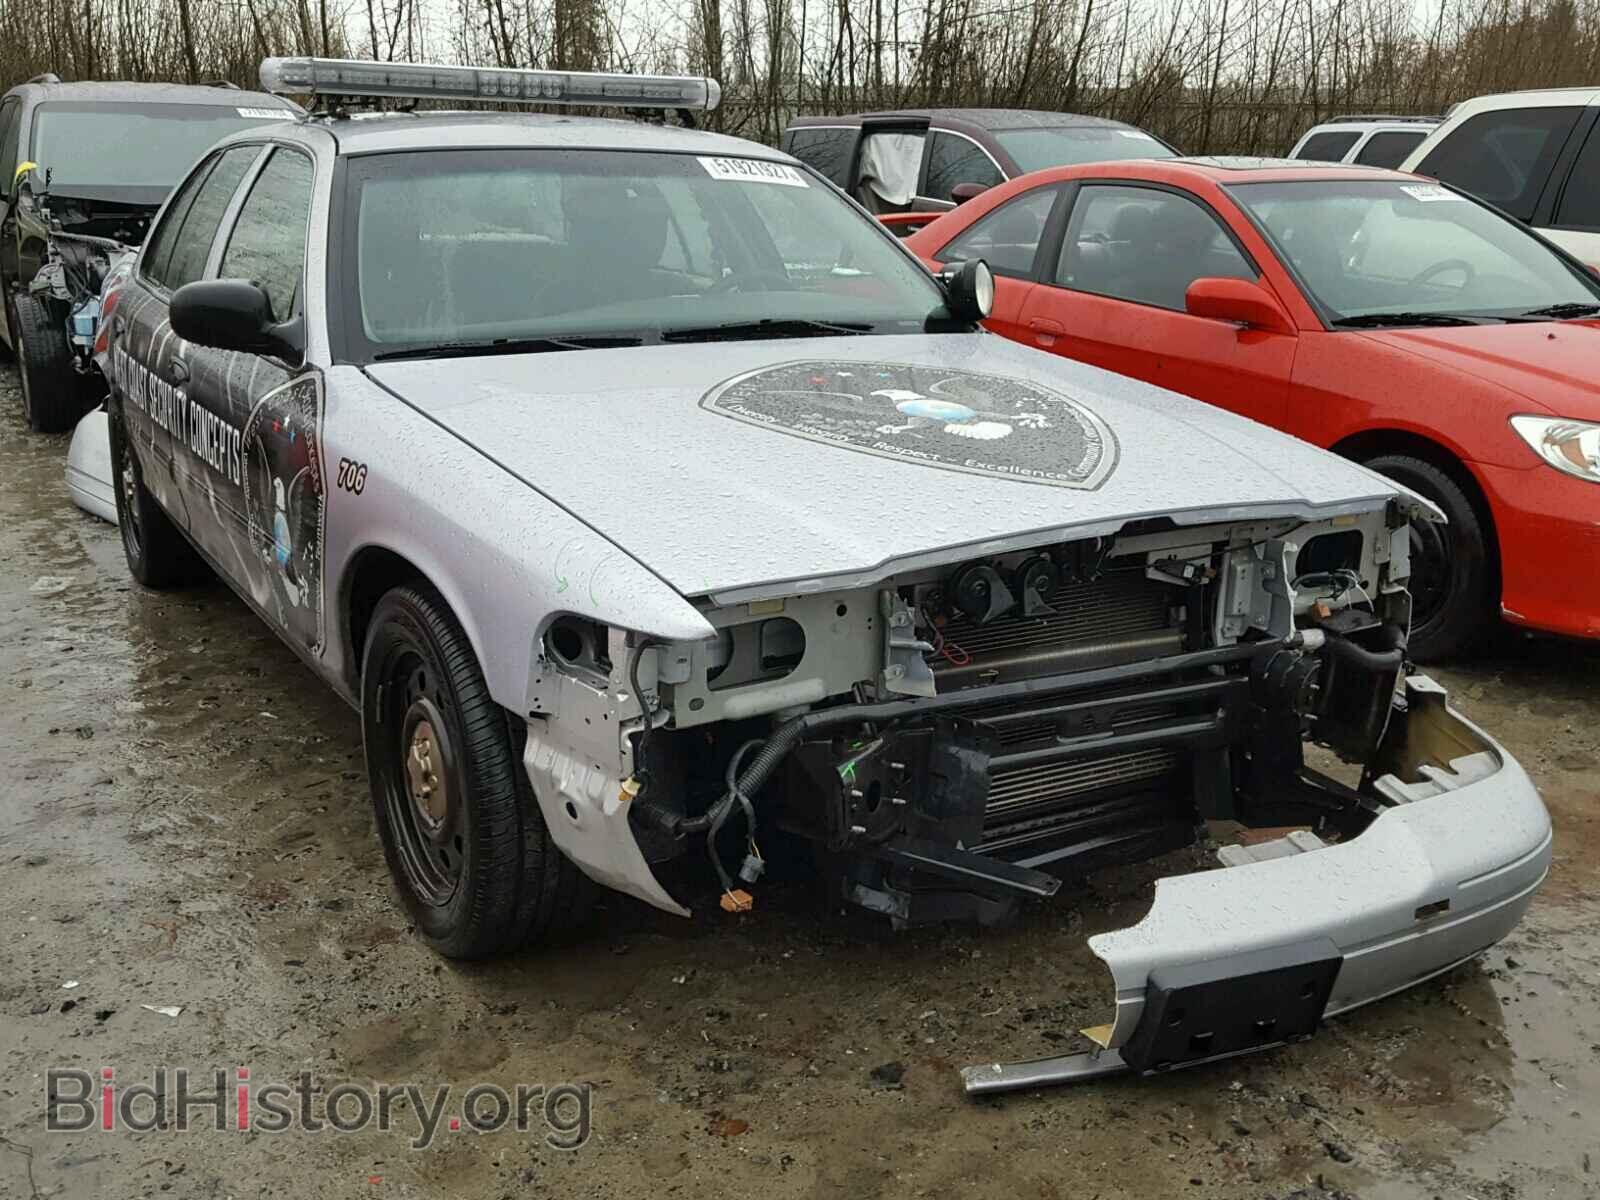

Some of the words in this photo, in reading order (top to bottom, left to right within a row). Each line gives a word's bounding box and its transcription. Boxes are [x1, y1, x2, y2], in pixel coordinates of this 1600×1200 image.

[149, 371, 188, 446] SECURITY
[190, 399, 240, 486] CONCEPTS
[337, 456, 368, 496] 706
[873, 440, 941, 461] Respect
[964, 458, 1069, 480] Excellence
